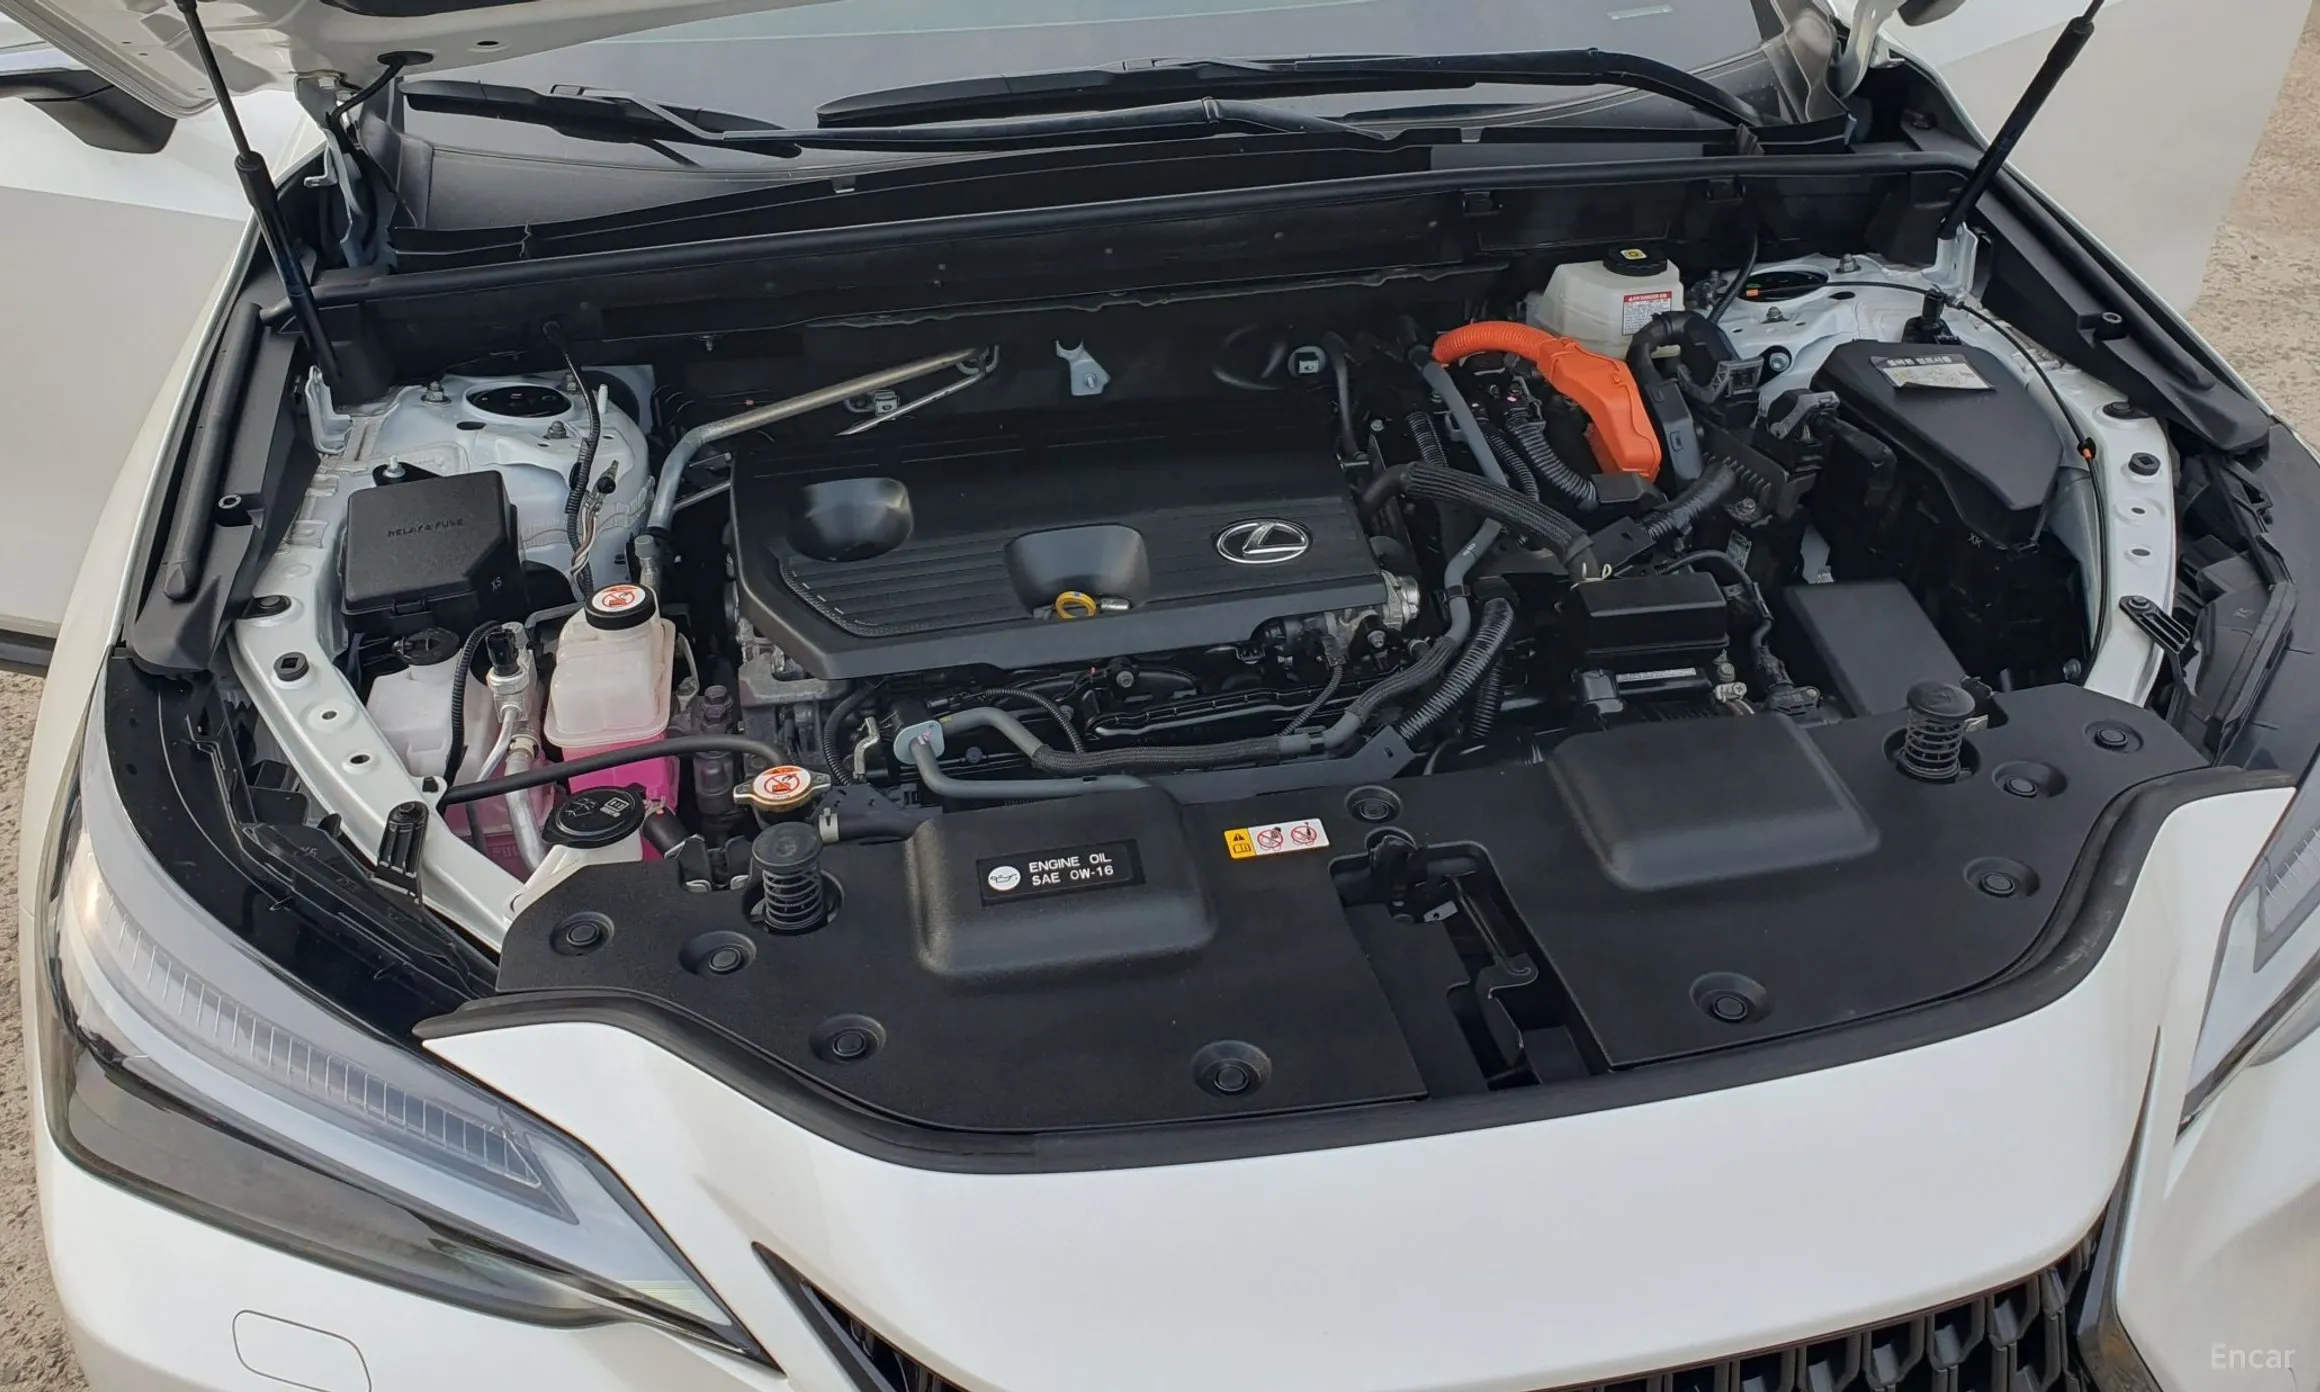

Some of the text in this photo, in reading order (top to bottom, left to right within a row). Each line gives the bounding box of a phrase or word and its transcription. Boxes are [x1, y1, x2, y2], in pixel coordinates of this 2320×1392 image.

[1028, 852, 1112, 874] ENGINE OIL
[1031, 865, 1114, 886] SAE 0W-16
